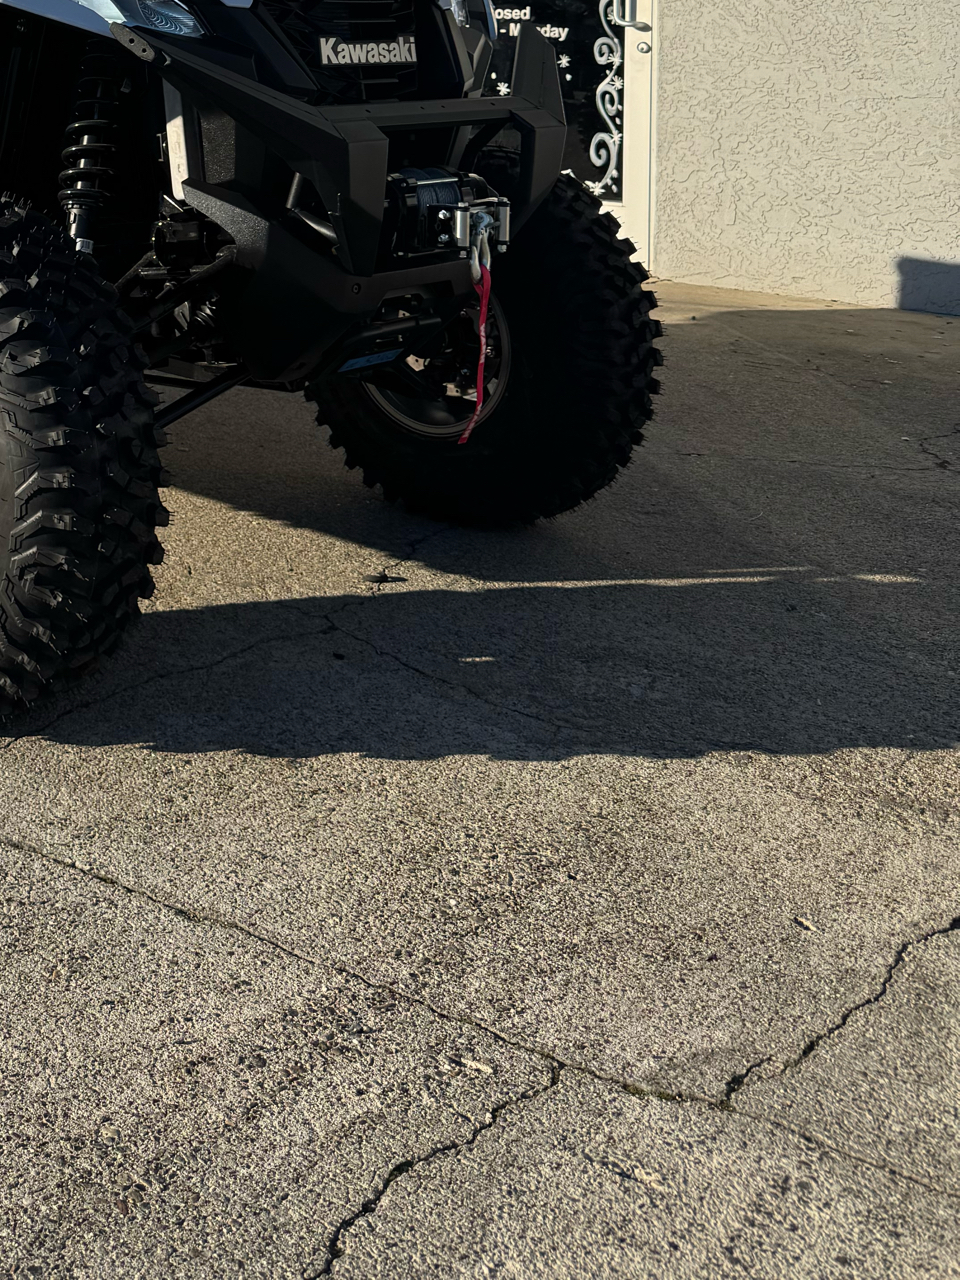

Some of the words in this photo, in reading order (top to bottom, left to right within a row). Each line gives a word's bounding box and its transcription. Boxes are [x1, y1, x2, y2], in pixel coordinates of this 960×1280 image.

[494, 6, 531, 20] osed
[509, 23, 569, 41] Mday
[320, 36, 418, 64] Kawasaki
